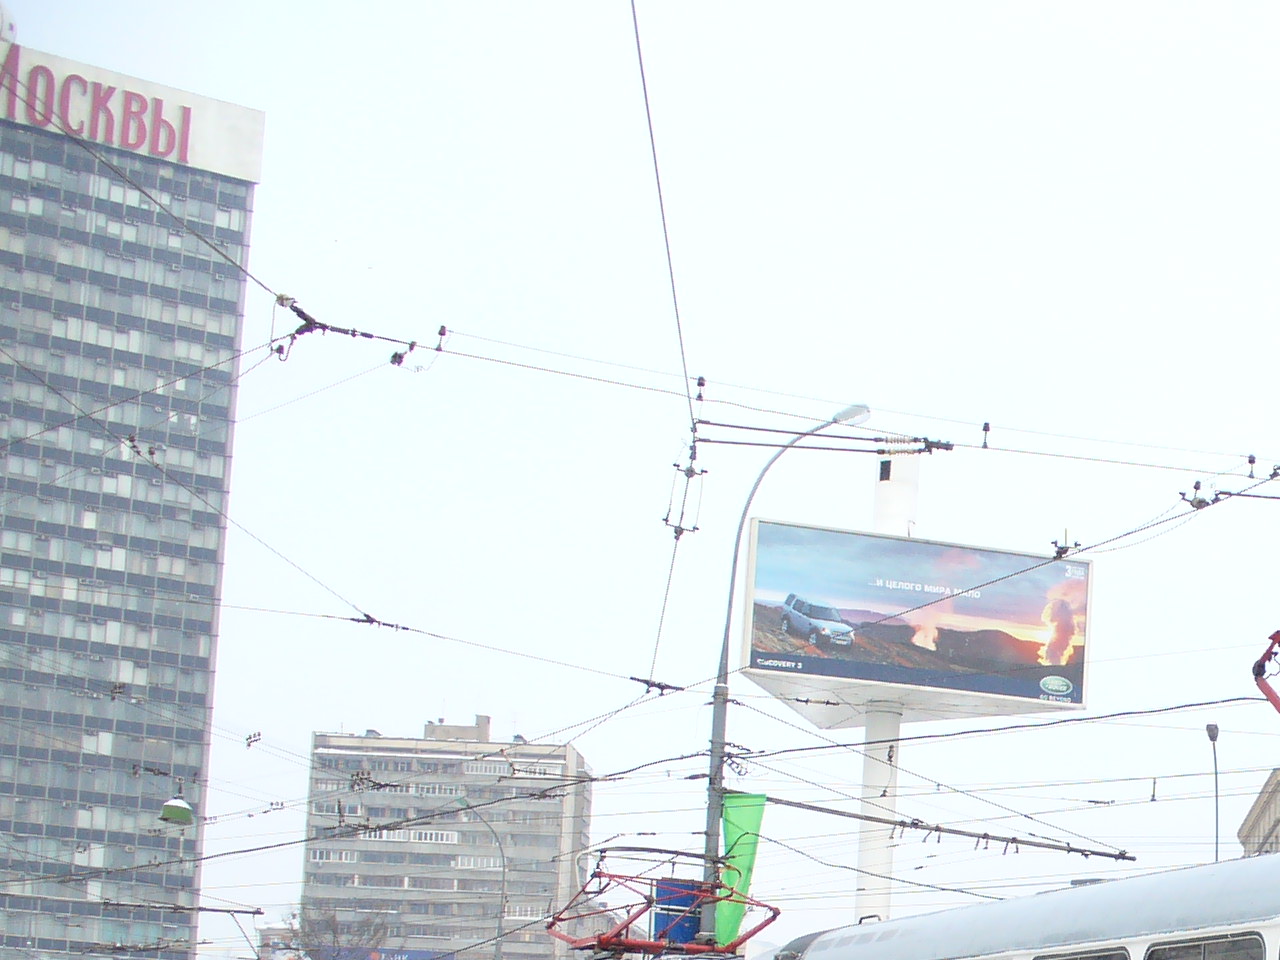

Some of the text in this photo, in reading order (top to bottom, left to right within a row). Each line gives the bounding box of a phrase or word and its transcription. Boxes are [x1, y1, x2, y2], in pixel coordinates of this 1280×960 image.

[885, 579, 922, 592] ЦЕЛОГО
[924, 584, 952, 596] МИРА
[954, 588, 981, 599] МАЛО
